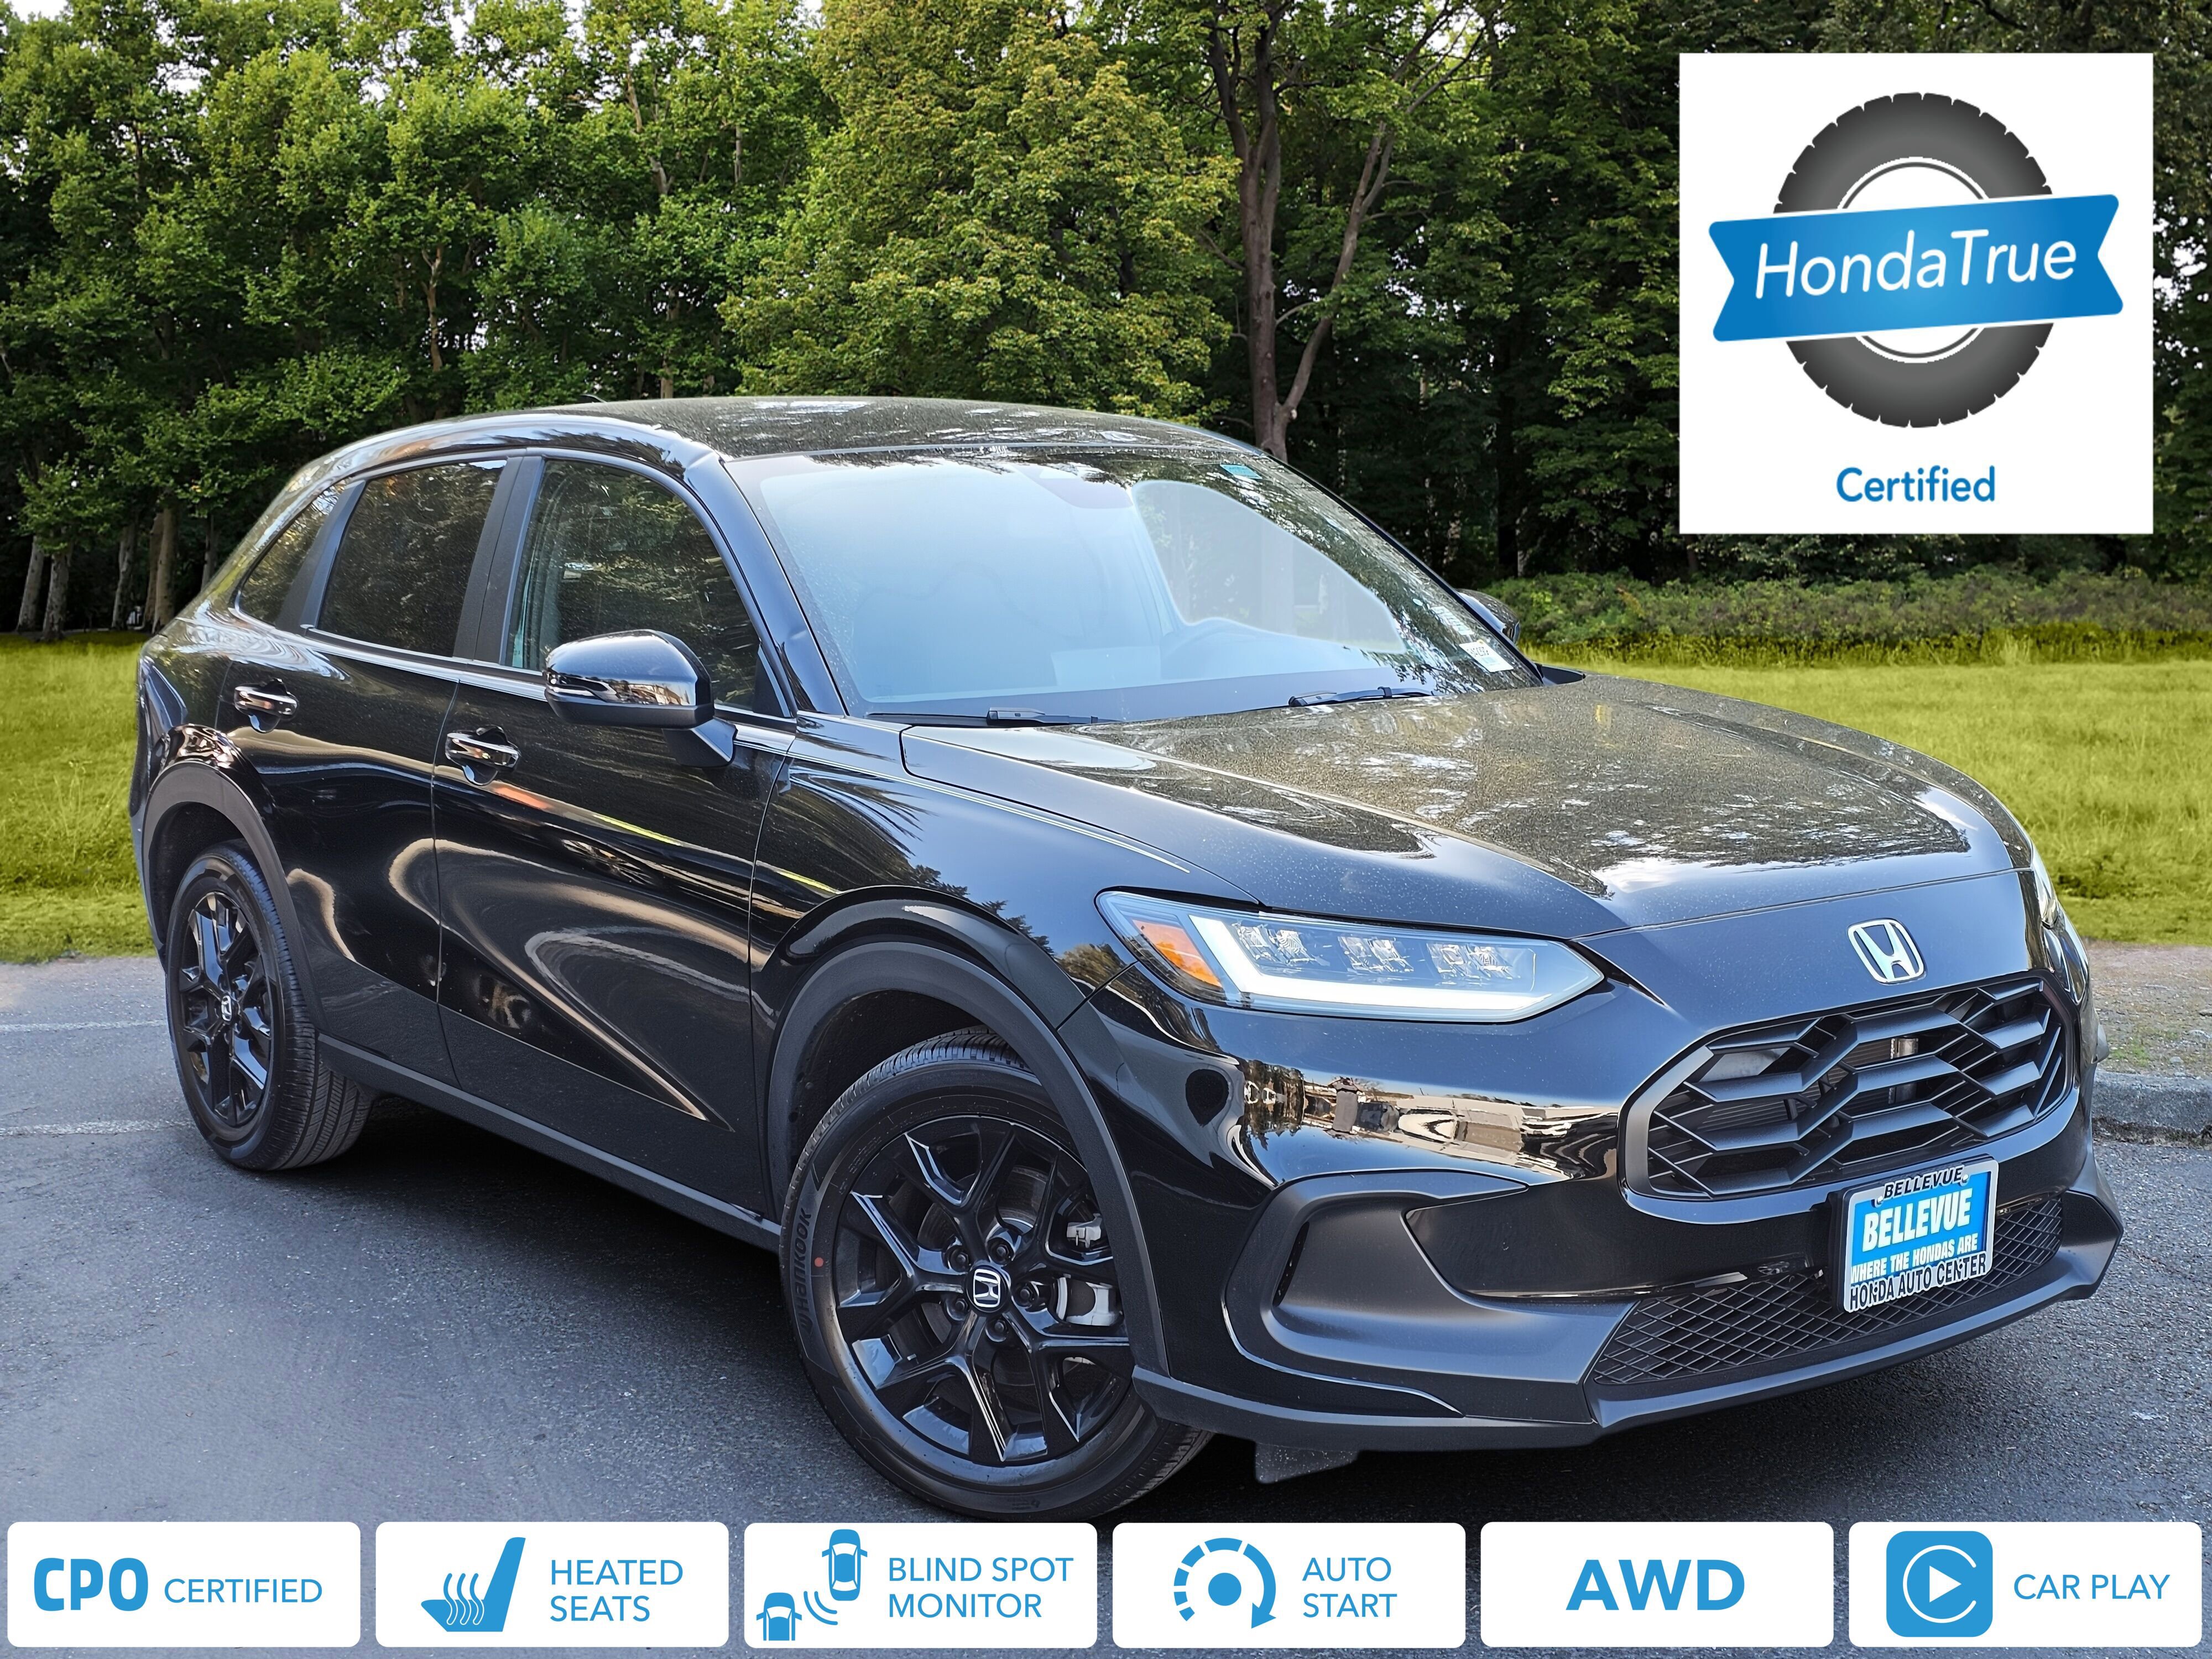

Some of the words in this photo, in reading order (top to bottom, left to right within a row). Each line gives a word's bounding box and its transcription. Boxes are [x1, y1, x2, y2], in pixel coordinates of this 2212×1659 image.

[1884, 1167, 1964, 1199] BELLEVUE
[1862, 1188, 1973, 1252] BELLEVUE
[1850, 1257, 1887, 1284] WHERE
[1890, 1251, 1910, 1273] THE
[1912, 1239, 1955, 1267] HONDAS
[1957, 1233, 1978, 1255] ARE
[1850, 1277, 1895, 1310] HONDA
[1898, 1267, 1932, 1297] AUTO
[1937, 1253, 1986, 1284] CENTER
